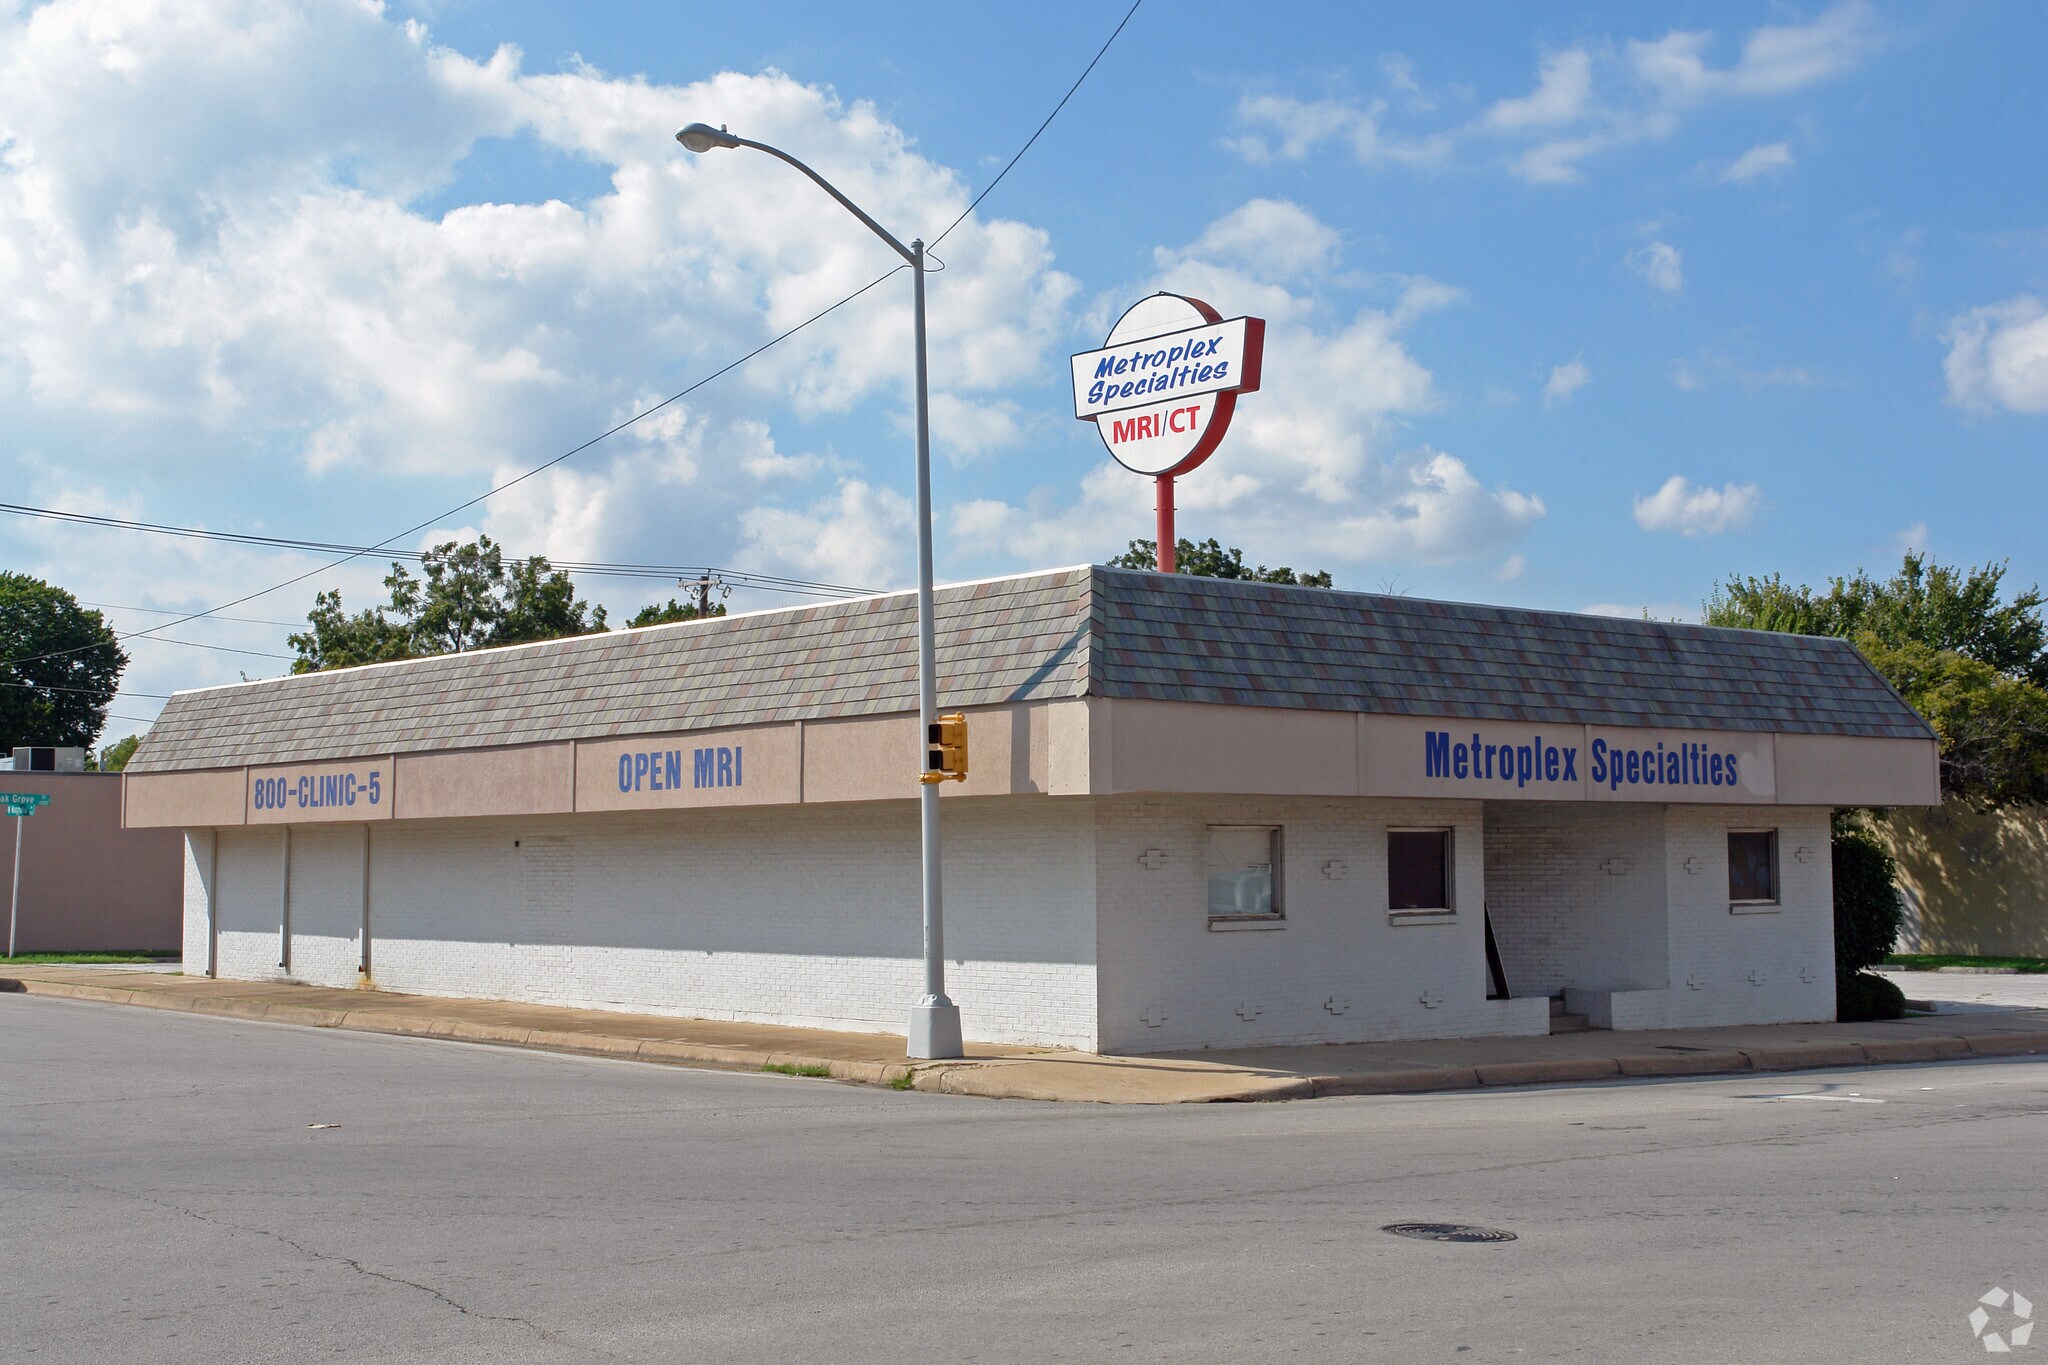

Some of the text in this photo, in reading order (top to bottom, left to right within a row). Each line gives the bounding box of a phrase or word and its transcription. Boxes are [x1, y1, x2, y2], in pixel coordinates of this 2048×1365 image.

[1094, 336, 1223, 379] Metroplex
[1087, 361, 1229, 405] Specialties
[1113, 405, 1201, 444] MRI/CT
[618, 746, 742, 793] OPEN MRI
[1425, 731, 1738, 791] Metroplex Specialties
[0, 795, 9, 803] ak
[12, 794, 35, 804] Grove
[254, 771, 381, 810] 800-CLINIC-5
